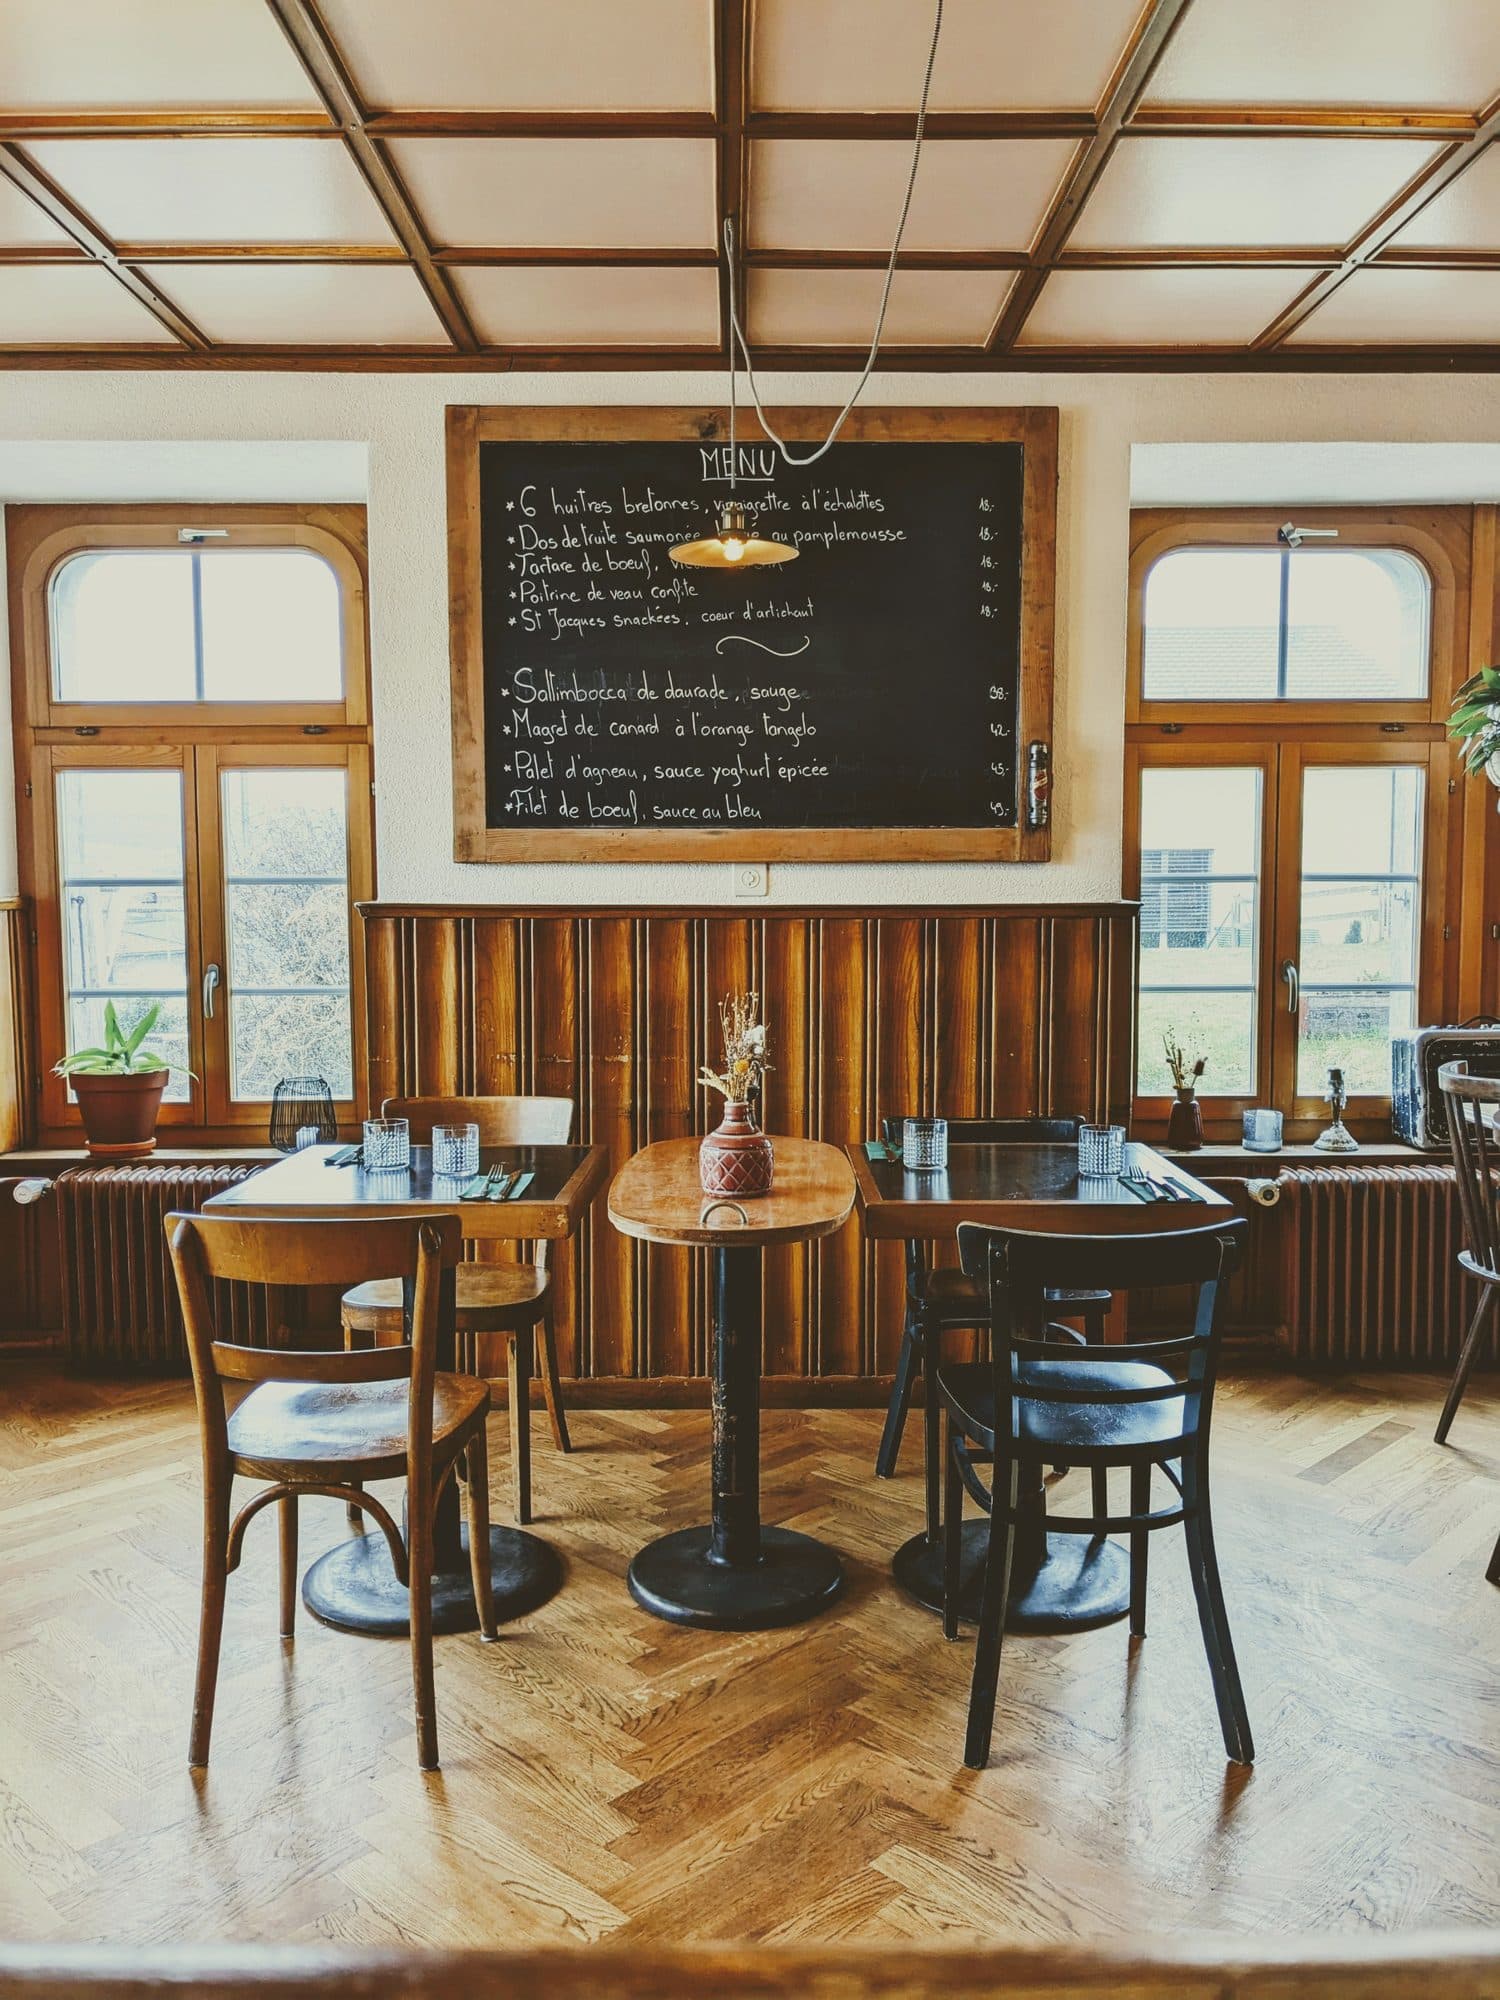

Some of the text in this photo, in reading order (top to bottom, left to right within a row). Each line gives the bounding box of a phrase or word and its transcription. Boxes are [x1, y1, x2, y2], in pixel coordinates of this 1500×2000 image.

[700, 447, 775, 478] MENU
[519, 485, 537, 517] 6
[518, 523, 559, 551] Dos
[561, 524, 582, 549] de
[580, 519, 618, 547] truite
[625, 524, 701, 545] saumonée
[771, 520, 907, 550] au pamplemousse
[514, 552, 577, 577] Tartare
[581, 551, 603, 574] de
[519, 577, 699, 605] Poitrine de veau confite
[520, 608, 542, 632] St
[547, 607, 607, 641] Jacques
[742, 596, 815, 622] d'artichaut
[513, 666, 628, 704] Saltimbocca
[636, 669, 660, 701] de
[750, 686, 802, 712] sauge
[511, 707, 817, 748] Magret de canard à l'orange tangelo
[514, 750, 554, 781] Palet
[653, 766, 705, 780] sauce
[711, 751, 772, 787] yoghurt
[777, 756, 830, 783] épicée
[509, 785, 548, 816] Filet
[558, 789, 580, 819] de
[652, 805, 699, 820] sauce
[701, 807, 722, 820] au
[724, 792, 762, 820] bleu
